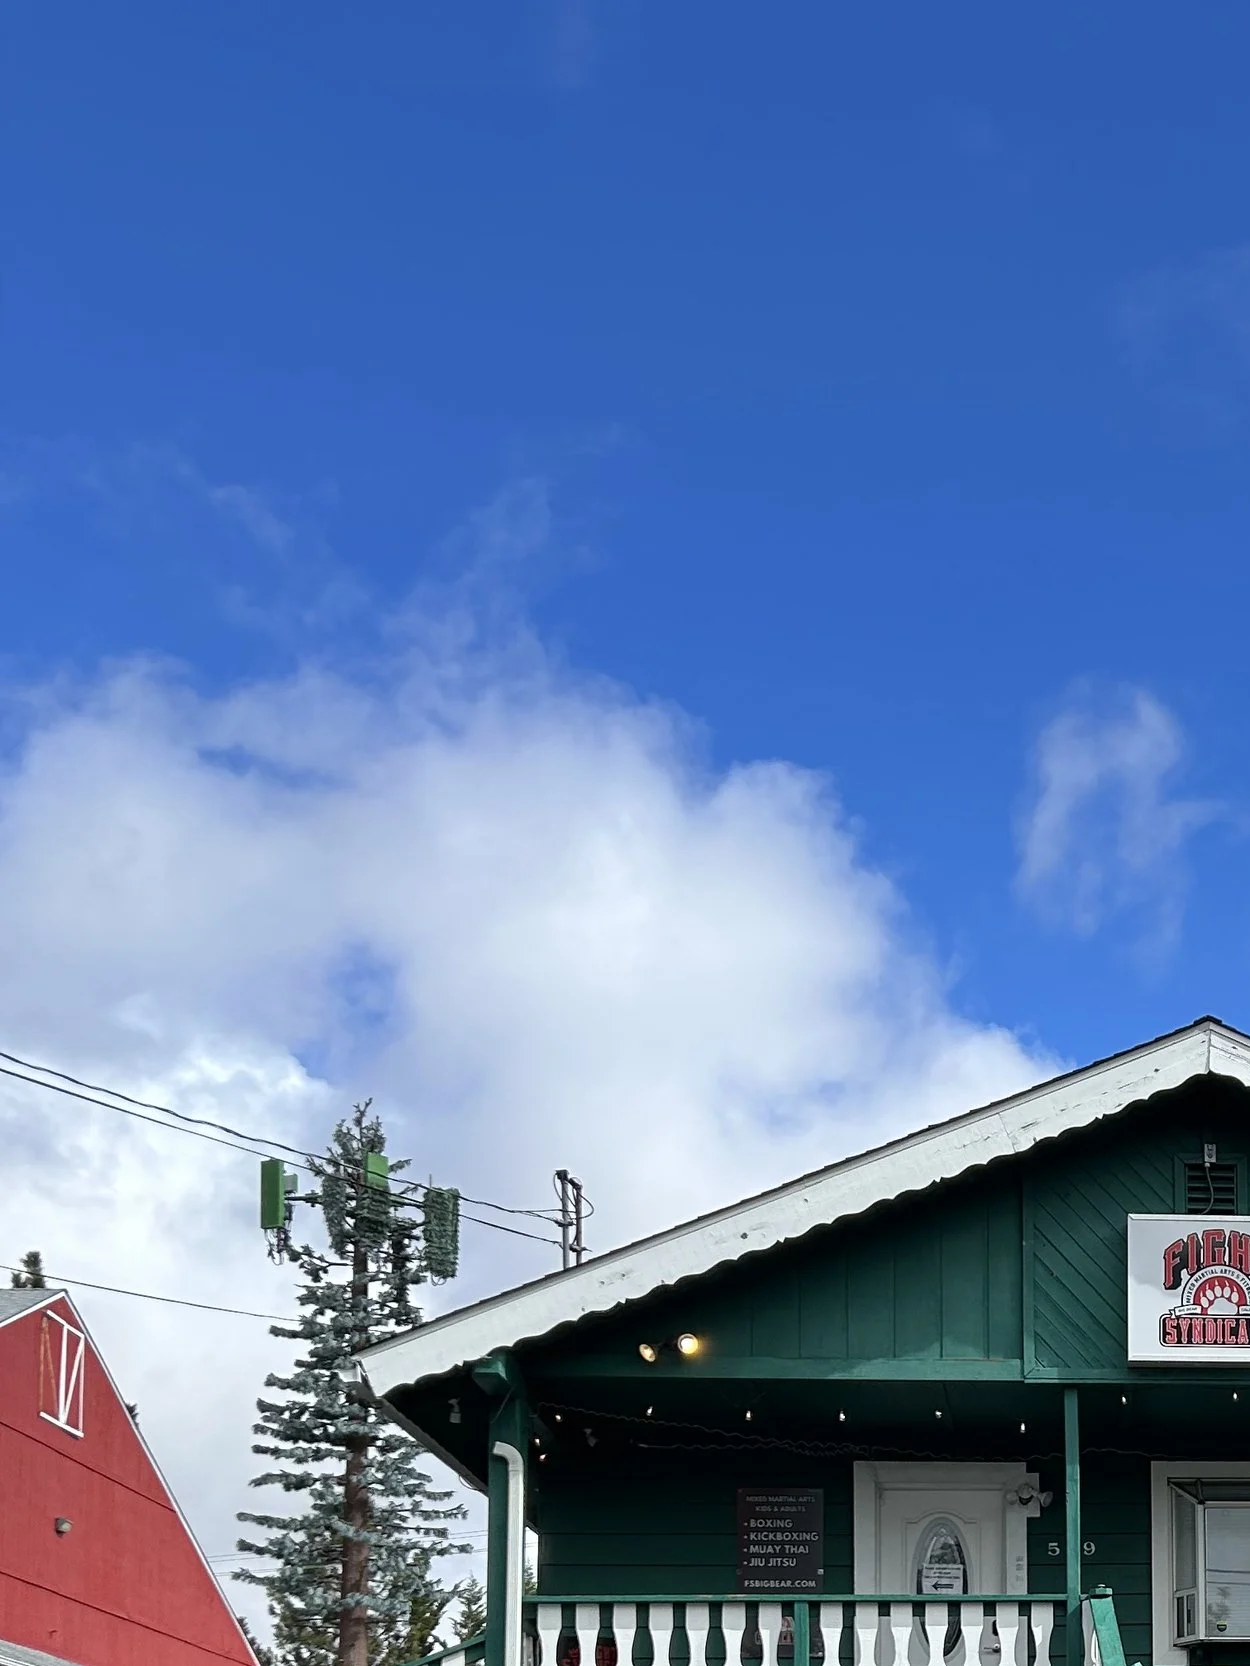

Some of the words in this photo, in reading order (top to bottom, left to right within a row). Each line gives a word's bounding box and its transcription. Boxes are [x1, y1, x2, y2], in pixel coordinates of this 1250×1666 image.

[1194, 1268, 1219, 1284] MARTIAL
[750, 1519, 793, 1528] BOXING
[750, 1532, 819, 1541] KICKBOXING
[749, 1545, 781, 1554] MUAY
[784, 1545, 809, 1554] THAI
[749, 1558, 765, 1567] JIU
[767, 1558, 797, 1567] JITSU
[744, 1580, 816, 1588] FSBIGBEAR.COM
